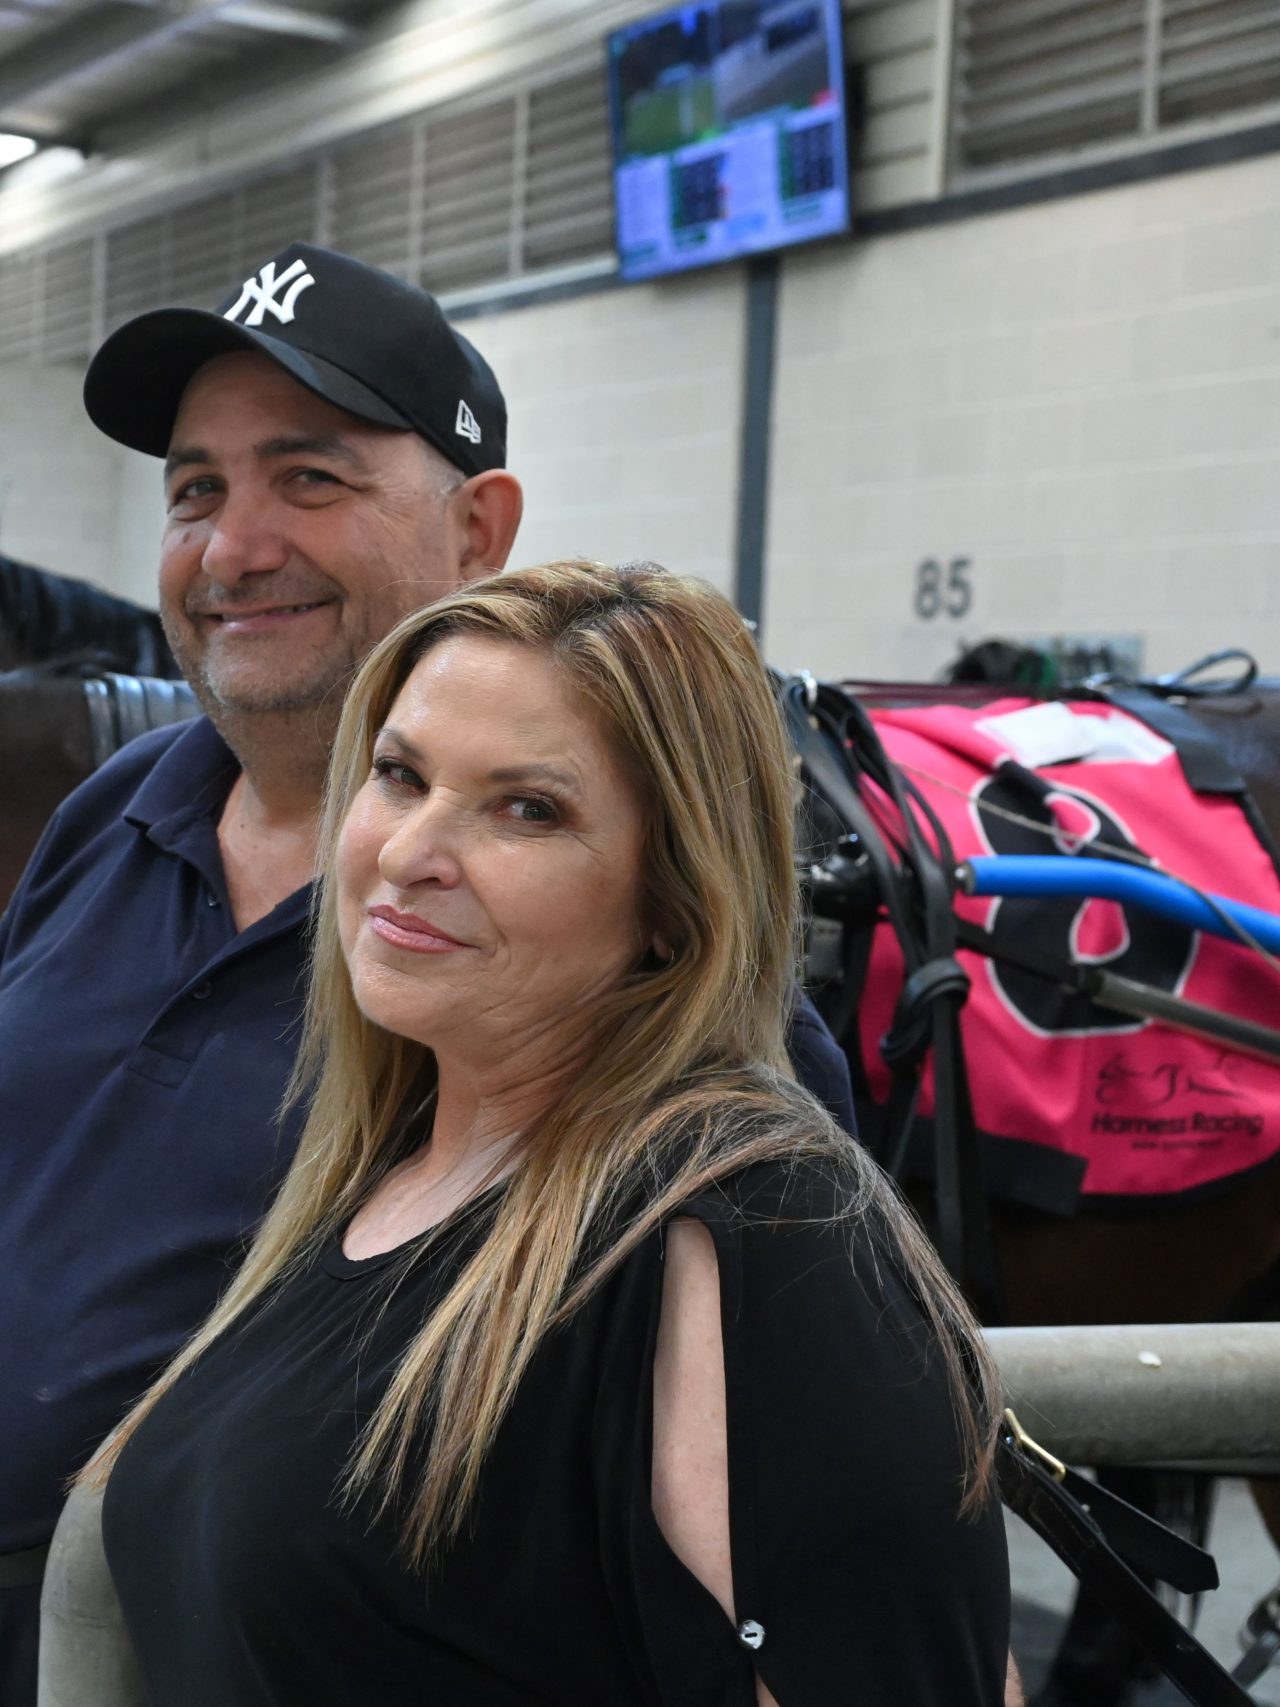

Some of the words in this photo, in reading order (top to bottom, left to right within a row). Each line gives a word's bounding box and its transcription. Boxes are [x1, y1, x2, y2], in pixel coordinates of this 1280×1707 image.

[223, 259, 316, 326] NY
[915, 559, 973, 619] 85
[1092, 1112, 1187, 1135] Harness
[1193, 1112, 1264, 1136] Racing
